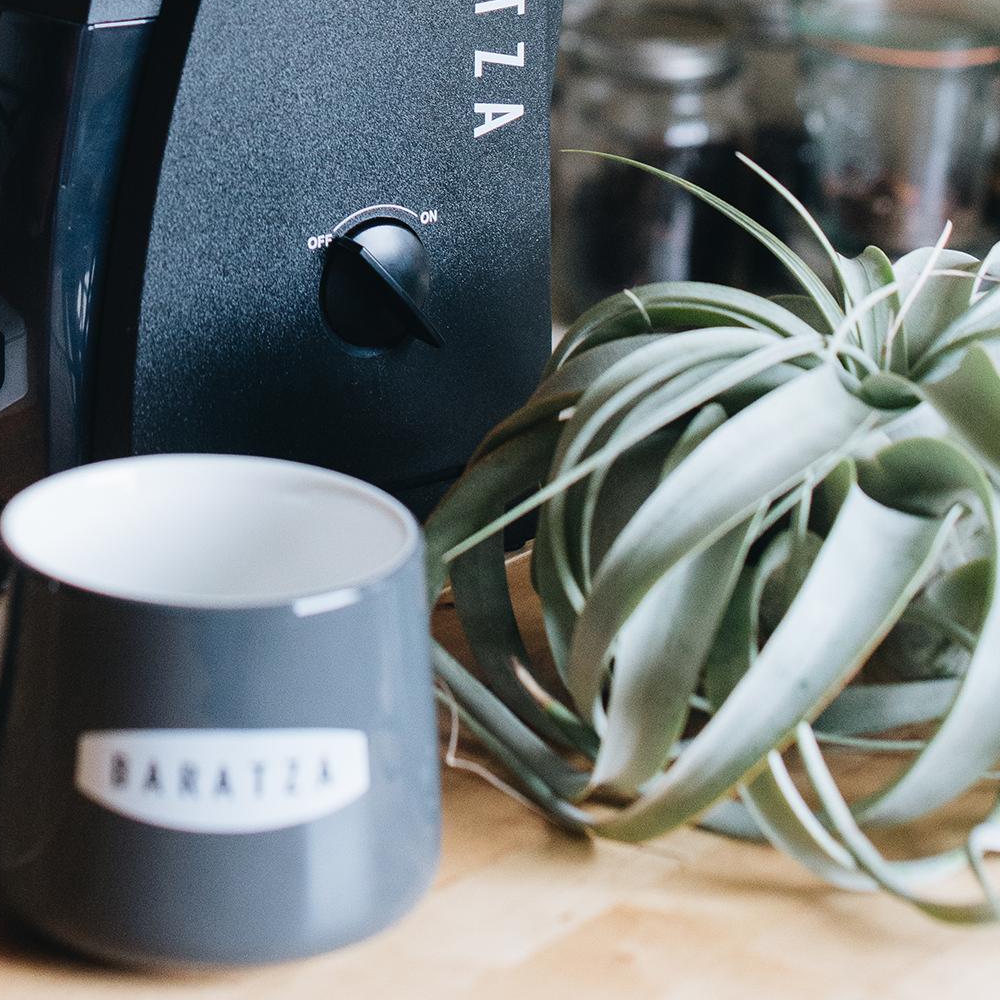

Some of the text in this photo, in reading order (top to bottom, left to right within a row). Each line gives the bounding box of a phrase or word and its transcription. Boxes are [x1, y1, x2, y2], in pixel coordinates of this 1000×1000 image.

[420, 210, 438, 225] ON
[307, 233, 333, 250] OFF
[109, 750, 334, 796] BARATZA
